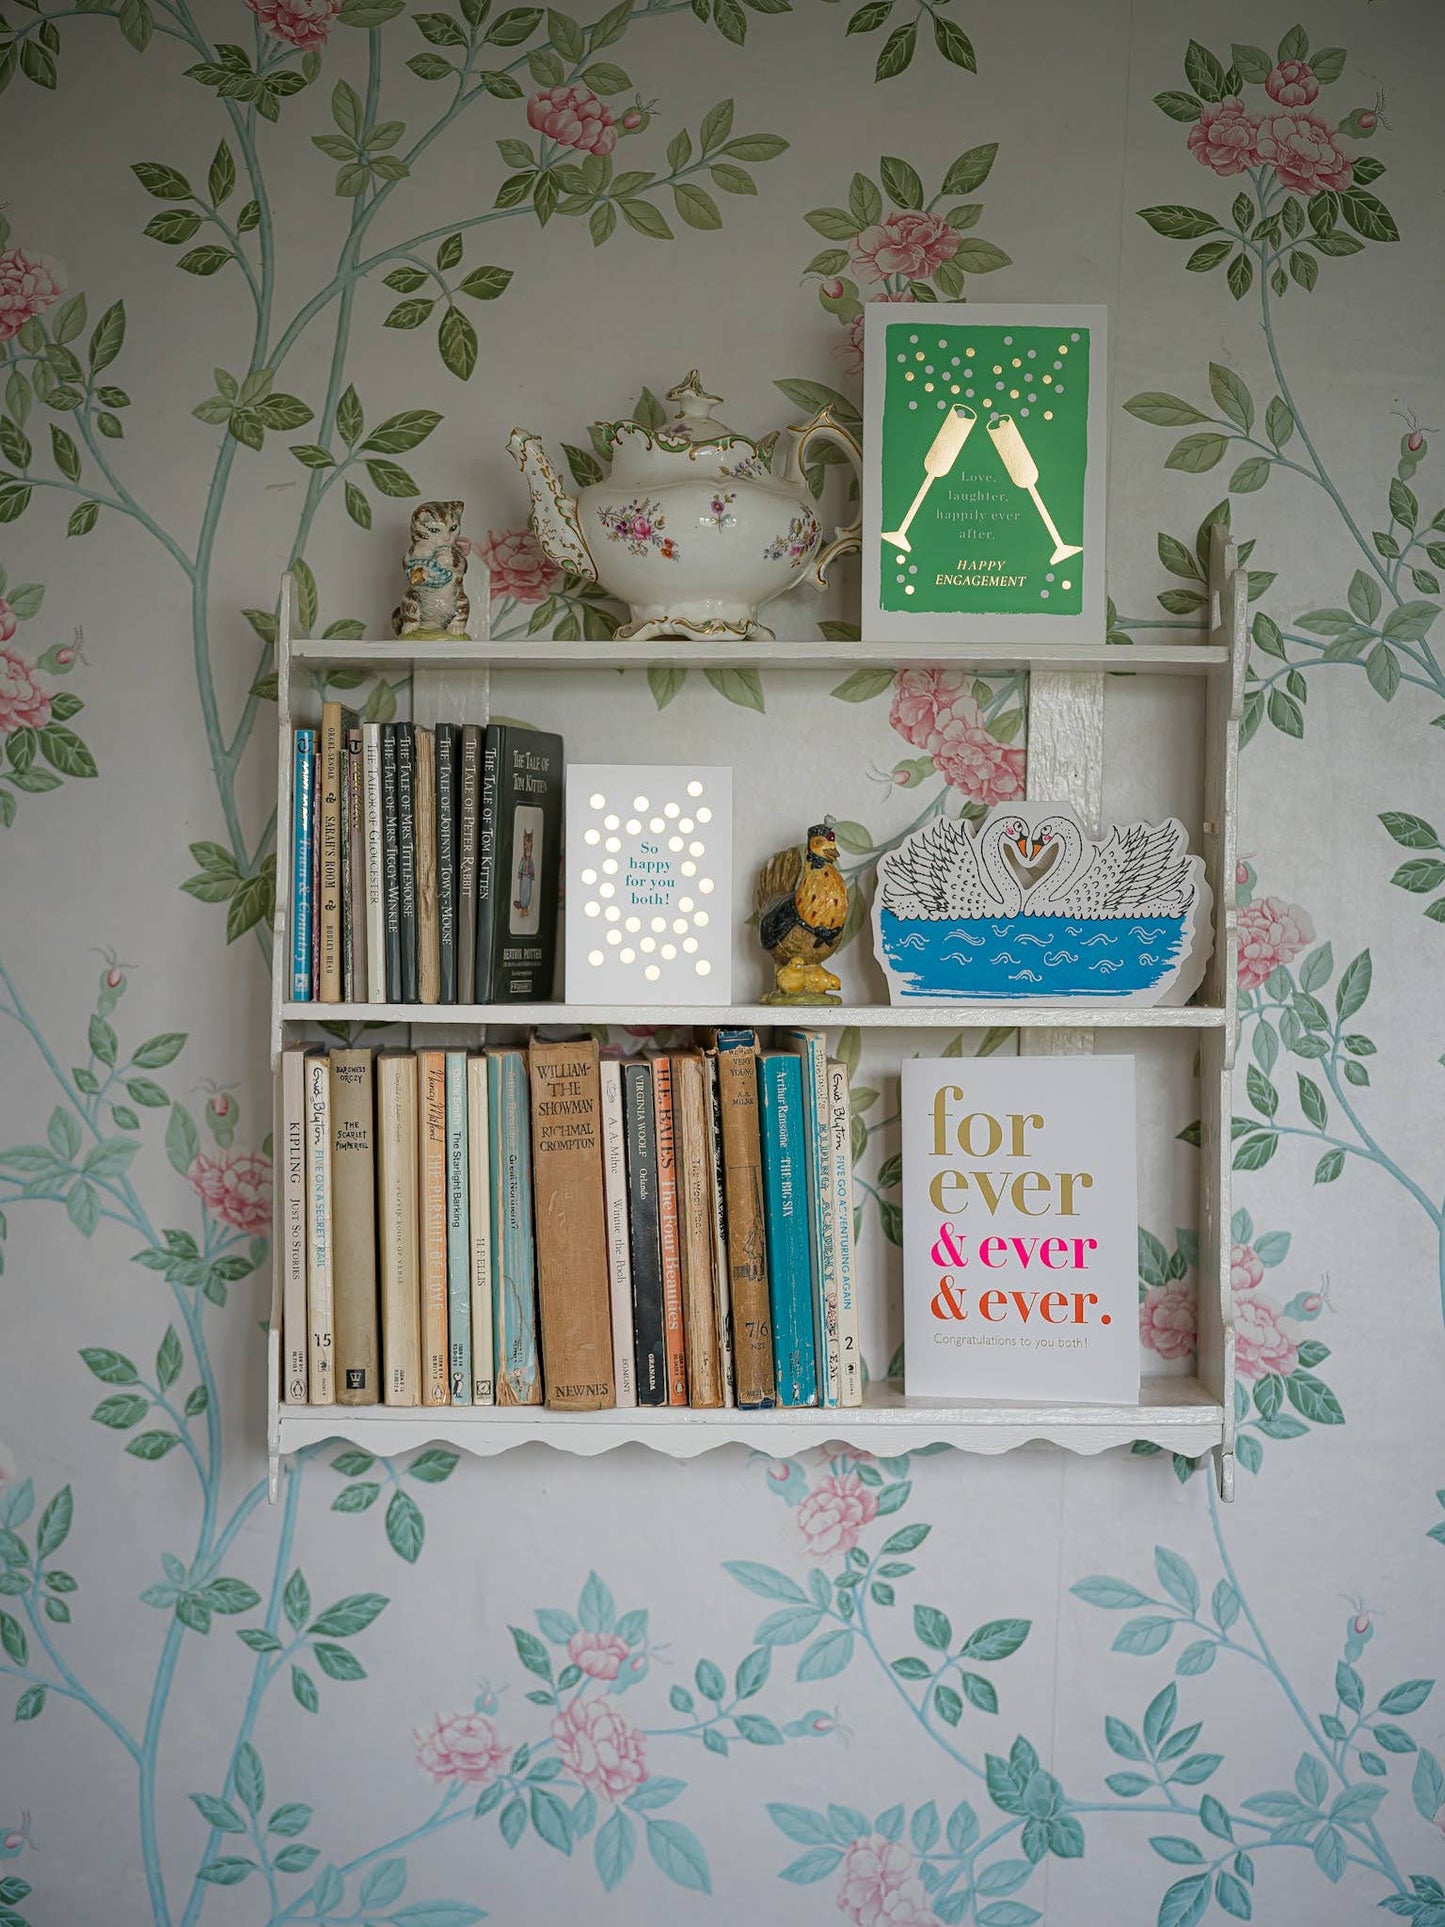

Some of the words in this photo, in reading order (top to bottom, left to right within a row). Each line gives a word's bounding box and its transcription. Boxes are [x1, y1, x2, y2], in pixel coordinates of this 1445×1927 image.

[948, 490, 1009, 502] laughter,
[936, 508, 985, 522] happily
[991, 513, 1020, 521] ever
[959, 528, 996, 540] after.
[957, 560, 1006, 571] HAPPY
[935, 574, 1027, 587] ENGAGEMENT
[366, 744, 379, 765] THE
[384, 737, 396, 760] THE
[400, 736, 412, 759] THE
[440, 738, 452, 761] THE
[465, 739, 477, 762] THE
[484, 748, 497, 771] THE
[513, 750, 525, 768] THE
[526, 752, 540, 770] TALE
[541, 757, 550, 771] OF
[367, 768, 379, 809] TAILOR
[385, 763, 396, 794] TALE
[400, 762, 412, 793] TALE
[440, 764, 452, 793] TALE
[464, 765, 477, 794] TALE
[483, 775, 496, 804] TALE
[513, 773, 525, 790] TOM
[526, 775, 548, 793] KITTEN
[385, 796, 395, 811] OF
[401, 795, 411, 811] OF
[441, 797, 451, 812] OF
[464, 797, 474, 813] OF
[481, 808, 492, 824] OF
[368, 811, 379, 826] OF
[325, 815, 336, 856] SARAH'S
[440, 814, 452, 861] JOHNNY
[463, 817, 475, 851] PETER
[481, 828, 493, 852] TOM
[641, 842, 658, 854] So
[325, 861, 336, 888] ROOM
[369, 830, 381, 905] GLOUCESTER
[460, 856, 474, 898] RABBIT
[479, 856, 492, 900] KITTEN
[629, 857, 671, 873] happy
[402, 842, 414, 918] TITTLEMOUSE
[626, 875, 646, 886] for
[649, 879, 675, 891] you
[440, 865, 453, 946] TOWN-MOUSE
[632, 893, 669, 905] both!
[294, 901, 311, 961] Country
[425, 1069, 444, 1101] Nancy
[547, 1081, 582, 1097] THE
[635, 1075, 646, 1121] VIRGINIA
[776, 1071, 787, 1104] Arthur
[833, 1073, 843, 1101] Enid
[538, 1099, 593, 1116] SHOWMAN
[310, 1101, 326, 1145] Blyton
[344, 1121, 359, 1131] THE
[426, 1102, 444, 1143] Mitford
[542, 1123, 594, 1138] RICHMAL
[777, 1105, 789, 1148] Ransome
[831, 1106, 847, 1151] Blyton
[928, 1085, 1045, 1157] for
[337, 1130, 368, 1139] SCARLET
[453, 1131, 462, 1149] The
[540, 1138, 595, 1152] CROMPTON
[637, 1122, 648, 1157] WOOLF
[659, 1109, 676, 1169] BATES
[289, 1122, 302, 1184] KIPLING
[314, 1149, 325, 1172] FIVE
[428, 1152, 441, 1178] THE
[610, 1146, 621, 1174] Milne
[837, 1155, 846, 1176] FIVE
[451, 1151, 462, 1190] Starlight
[780, 1157, 792, 1180] THE
[315, 1174, 325, 1191] ON
[640, 1168, 649, 1200] Orlando
[661, 1179, 677, 1210] The
[781, 1182, 793, 1199] BIG
[837, 1179, 847, 1197] GO
[929, 1169, 1094, 1216] ever
[289, 1199, 301, 1221] JUST
[315, 1203, 326, 1238] SECRET
[428, 1185, 442, 1243] PURSUIT
[451, 1192, 462, 1228] Barking
[782, 1201, 794, 1217] SIX
[291, 1224, 302, 1238] SO
[663, 1215, 679, 1254] Four
[315, 1242, 326, 1268] TRAIL
[930, 1221, 968, 1268] &
[978, 1235, 1098, 1270] ever
[291, 1241, 302, 1281] STORIES
[477, 1259, 486, 1287] ELLIS
[664, 1256, 682, 1330] Beauties
[843, 1276, 852, 1310] AGAIN
[930, 1274, 968, 1321] &
[978, 1289, 1112, 1325] ever.
[315, 1333, 331, 1347] 15
[746, 1321, 769, 1338] 7/6
[933, 1332, 1017, 1347] Congratulations
[1019, 1337, 1032, 1347] to
[1035, 1338, 1055, 1349] you
[1058, 1337, 1089, 1348] both!
[845, 1336, 854, 1350] 2
[621, 1358, 631, 1393] EGMONT
[647, 1353, 657, 1391] GRANADA
[554, 1383, 609, 1398] NEWNES
